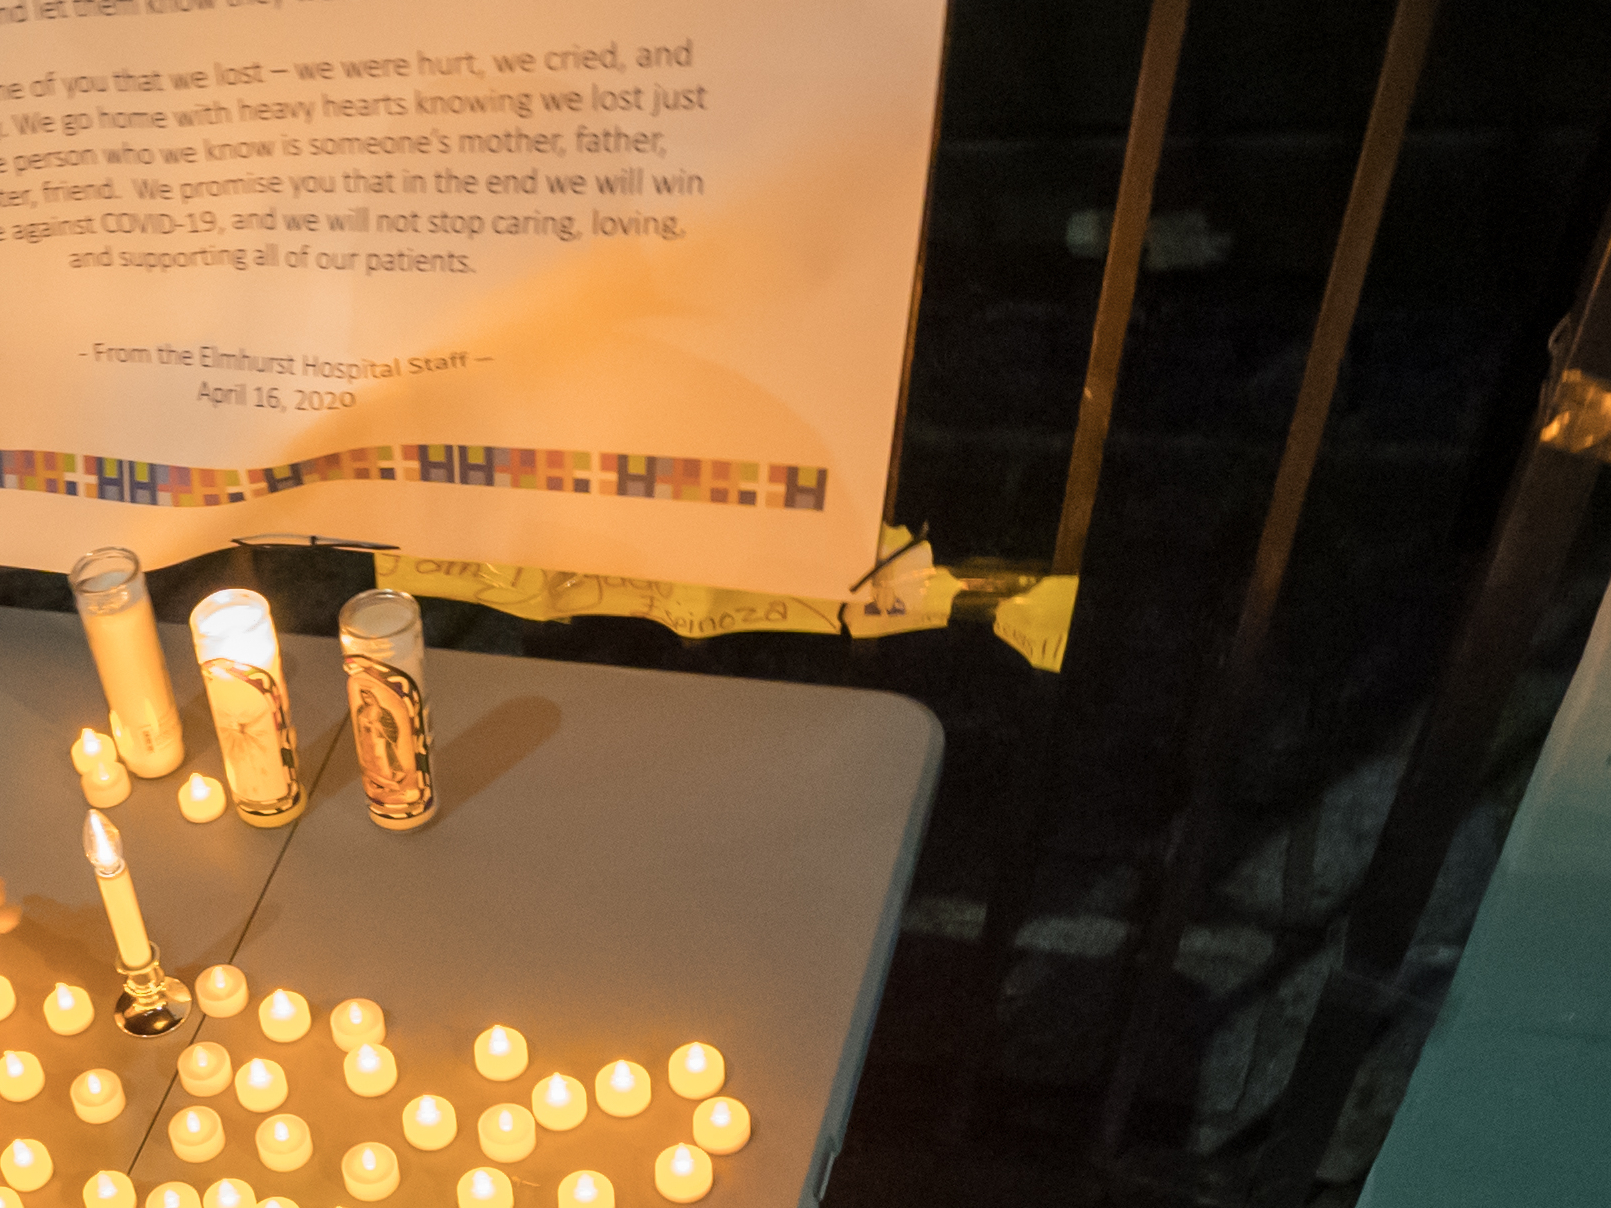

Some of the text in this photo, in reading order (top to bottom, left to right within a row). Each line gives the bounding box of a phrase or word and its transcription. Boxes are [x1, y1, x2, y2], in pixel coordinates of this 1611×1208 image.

[29, 70, 56, 97] of
[61, 75, 109, 99] you
[112, 68, 165, 92] that
[168, 70, 209, 91] we
[213, 61, 265, 86] lost
[293, 61, 334, 81] we
[340, 57, 411, 78] were
[415, 49, 486, 79] hurt,
[491, 52, 536, 73] we
[544, 42, 627, 74] cried,
[635, 37, 693, 68] and
[10, 111, 56, 135] We
[61, 113, 94, 137] go
[96, 105, 169, 129] home
[171, 101, 233, 127] with
[236, 97, 316, 124] heavy
[320, 92, 408, 117] hearts
[413, 87, 534, 119] knowing
[540, 90, 583, 112] we
[592, 81, 643, 111] lost
[650, 81, 708, 117] just
[13, 148, 99, 177] person
[101, 141, 156, 165] who
[158, 145, 198, 165] we
[202, 137, 276, 162] know
[280, 133, 303, 156] is
[458, 125, 567, 158] mother,
[575, 123, 667, 159] father,
[41, 176, 122, 204] friend.
[130, 178, 174, 201] We
[178, 171, 283, 205] promise
[287, 174, 337, 199] you
[341, 167, 396, 195] that
[401, 167, 428, 195] in
[433, 167, 480, 196] the
[485, 166, 539, 196] end
[545, 172, 588, 196] we
[594, 166, 645, 197] will
[651, 166, 705, 196] win
[11, 215, 97, 244] against
[100, 210, 226, 236] COVID-19,
[230, 205, 277, 231] and
[281, 212, 320, 232] we
[325, 206, 370, 233] will
[376, 210, 421, 234] not
[426, 209, 486, 240] stop
[491, 208, 584, 242] caring,
[592, 207, 686, 241] loving,
[68, 242, 477, 277] and supporting all of our patients.
[92, 342, 152, 366] From
[157, 343, 193, 367] the
[198, 345, 297, 377] Elmhurst
[301, 353, 402, 384] Hospital
[408, 350, 470, 376] Staff
[196, 381, 357, 414] April 16, 2020
